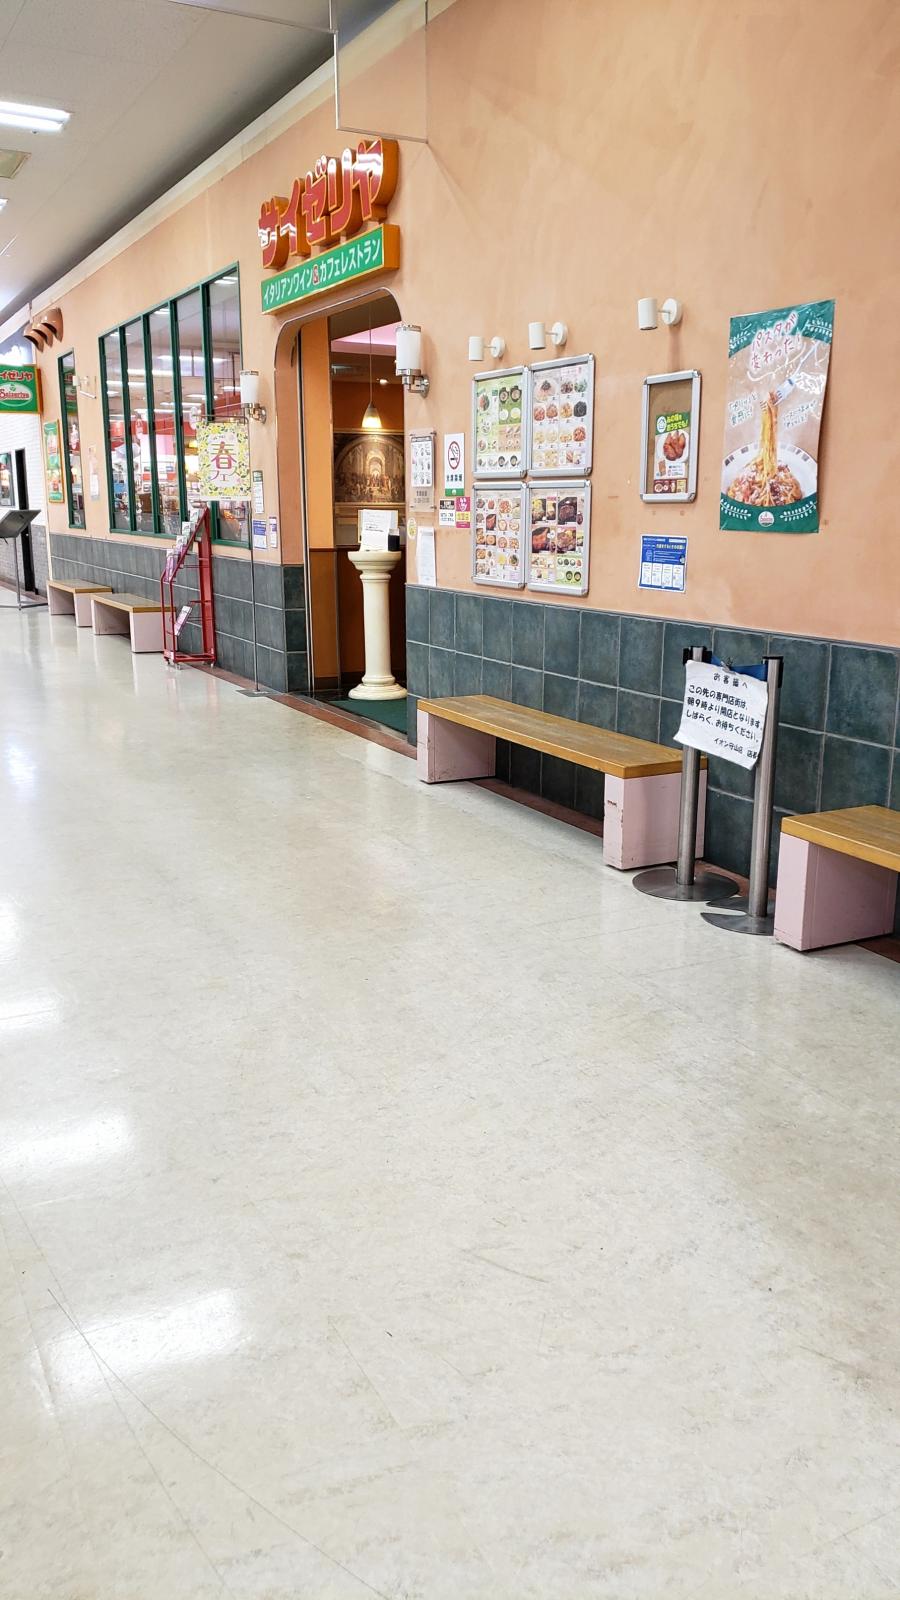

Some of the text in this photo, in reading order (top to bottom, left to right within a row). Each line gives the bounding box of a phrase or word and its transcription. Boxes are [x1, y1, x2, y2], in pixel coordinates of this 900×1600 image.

[258, 137, 385, 268] サイゼリヤ
[263, 238, 381, 305] イタリアンワイン&カフェレストラン
[0, 370, 33, 381] イゼリヤ
[210, 441, 237, 469] 春
[208, 466, 241, 481] フェス
[688, 684, 748, 711] この先の専門店街は、
[686, 709, 759, 743] しばらく、お待ちください。
